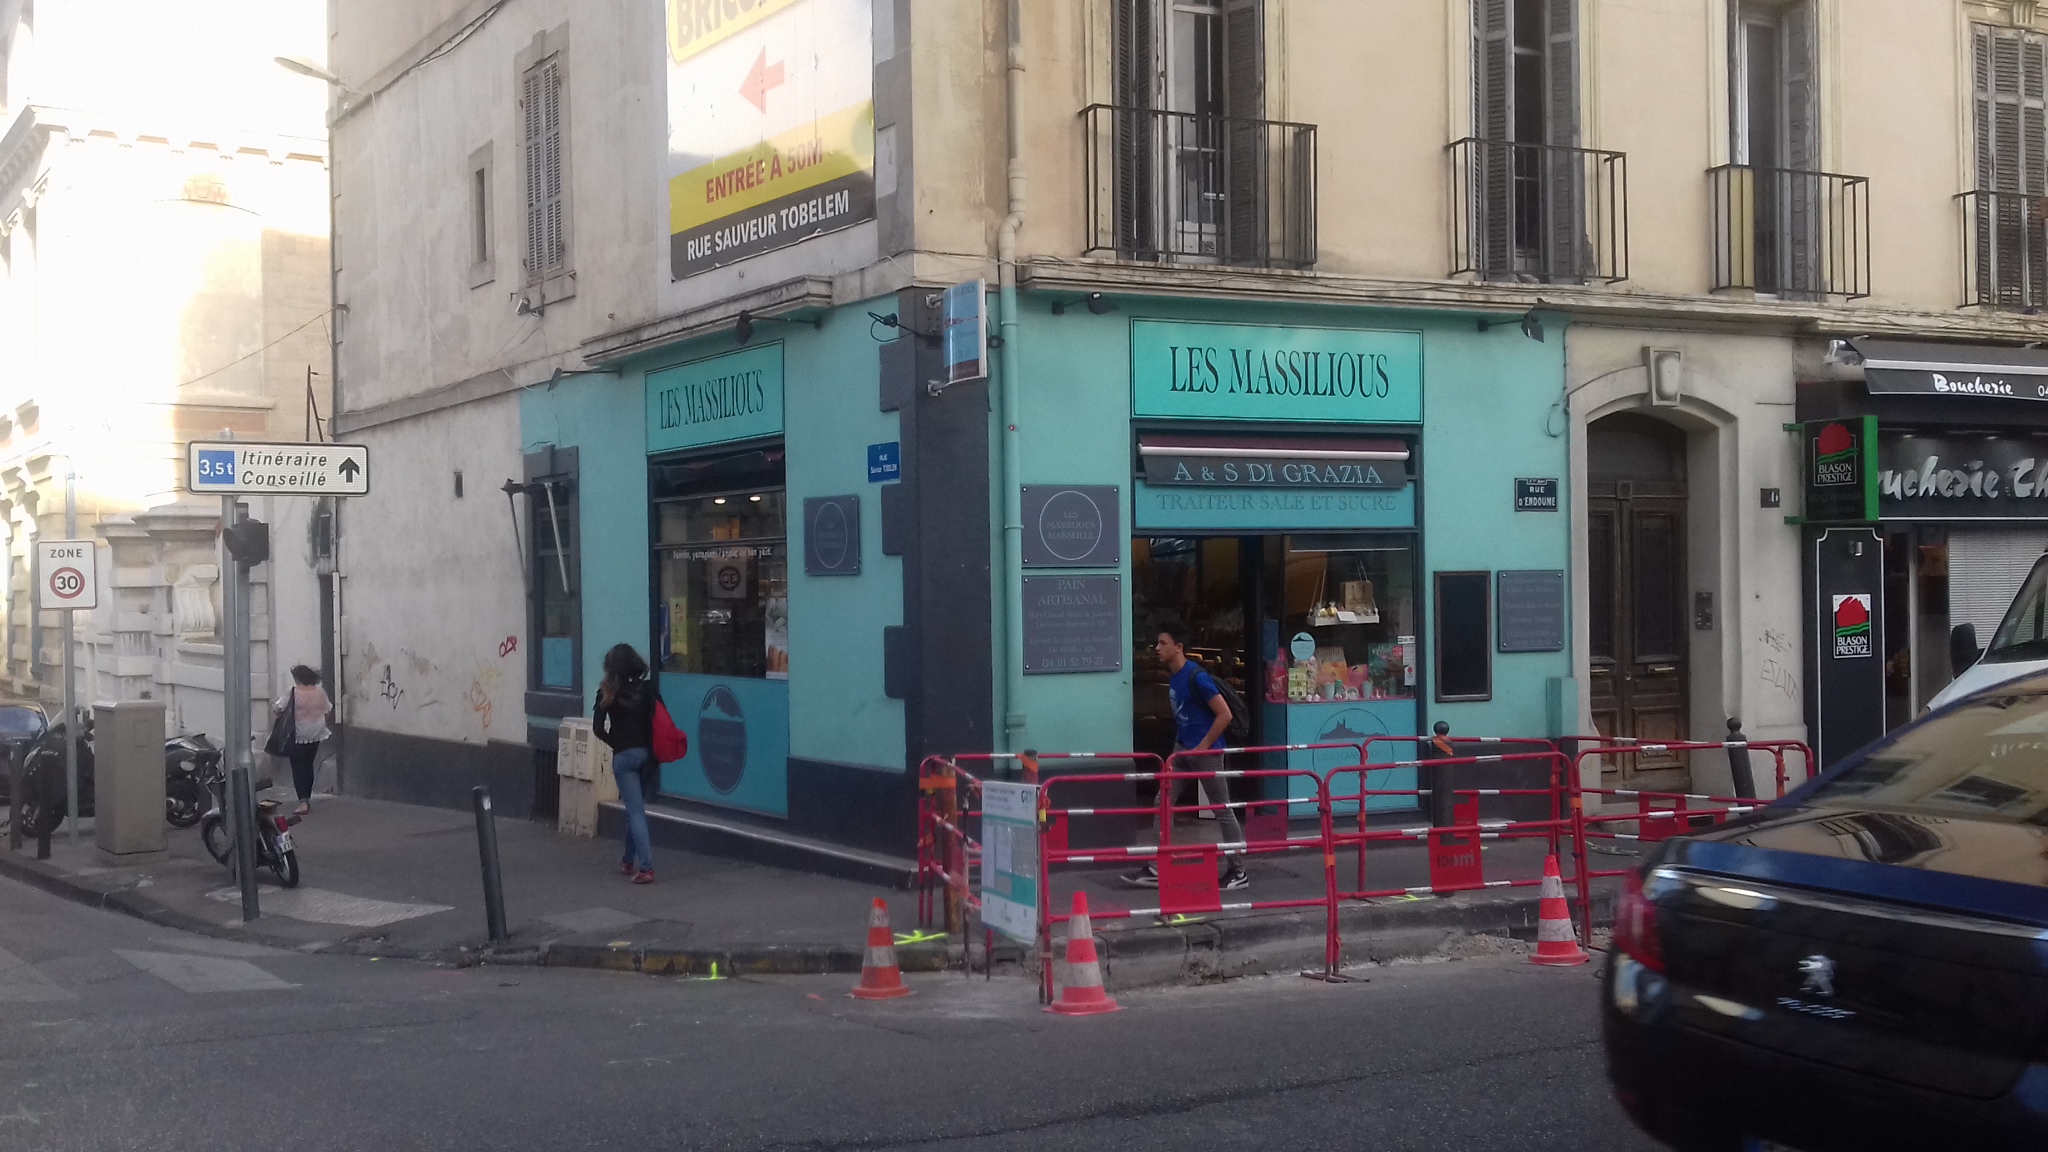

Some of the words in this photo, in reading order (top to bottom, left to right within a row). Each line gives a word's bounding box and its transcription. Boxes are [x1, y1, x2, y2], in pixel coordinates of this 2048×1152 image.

[677, 0, 767, 49] BRI
[706, 157, 765, 203] ENTRÉE
[770, 150, 782, 180] À
[787, 137, 823, 173] 50M
[687, 235, 712, 261] RUE
[715, 215, 777, 252] SAUVEUR
[780, 190, 849, 231] TOBELEM
[1169, 346, 1219, 394] LES
[1228, 348, 1389, 398] MASSILIOUS
[1932, 374, 2013, 394] Boucherie
[659, 388, 681, 430] LES
[684, 369, 764, 425] MASSILIOUS
[242, 451, 327, 466] Itinéraire
[1174, 462, 1194, 481] A
[1201, 466, 1216, 481] &
[1224, 463, 1239, 482] S
[1245, 463, 1276, 482] DI
[1282, 464, 1383, 484] GRAZIA
[1818, 463, 1852, 474] BLASON
[242, 470, 326, 486] Conseillé
[1817, 472, 1853, 483] PRESTIGE
[1881, 455, 2000, 500] ucherie
[1156, 494, 1255, 510] TRAITEUR
[1311, 495, 1334, 510] ET
[1338, 492, 1396, 511] SUCRÉ
[1063, 511, 1079, 519] LES
[1047, 531, 1095, 540] MARSEILLE
[50, 548, 83, 558] ZONE
[56, 575, 78, 590] 30
[1058, 579, 1086, 590] PAIN
[1037, 594, 1106, 606] ARTISANAL
[1837, 635, 1868, 646] BLASON
[1836, 645, 1870, 655] PRESTIGE
